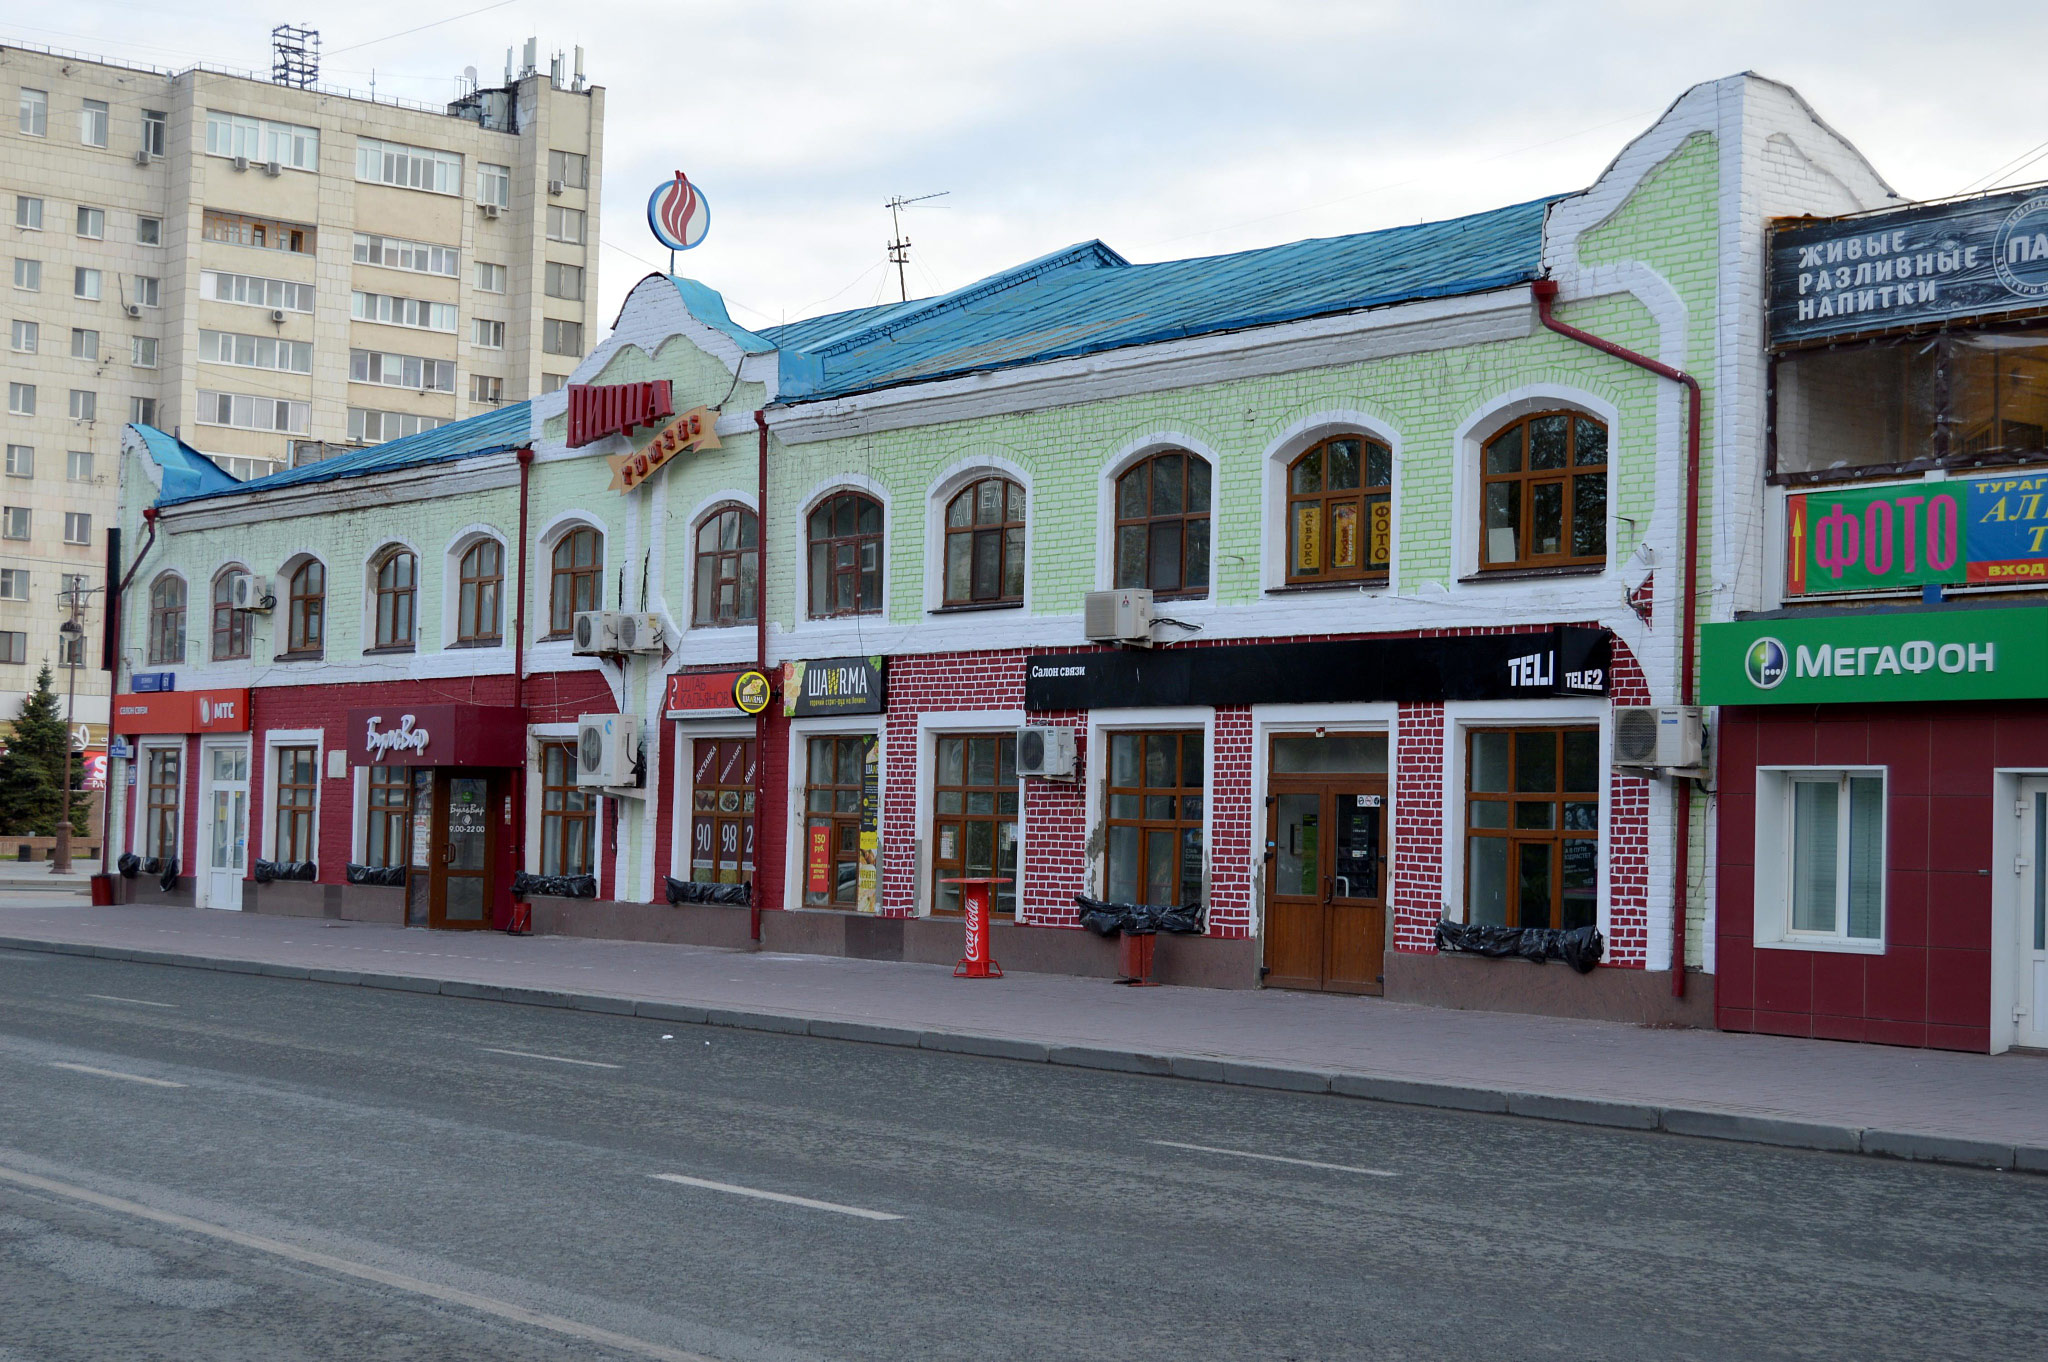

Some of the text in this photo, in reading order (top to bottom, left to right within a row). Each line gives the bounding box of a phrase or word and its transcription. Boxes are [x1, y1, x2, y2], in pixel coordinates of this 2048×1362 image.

[2006, 200, 2048, 226] ЦЕНТРА
[1798, 230, 1905, 268] ЖИВЫЕ
[1798, 246, 1979, 295] РАЗЛИВНЫЕ
[1798, 280, 1936, 321] НАПИТКИ
[566, 380, 675, 449] ПИЦЦА
[1979, 493, 2048, 523] АЛ
[1375, 505, 1390, 560] ФОТО
[1815, 494, 1958, 579] ФОТО
[1988, 563, 2045, 577] ВХОД
[681, 676, 706, 692] ШТАБ
[1031, 665, 1085, 678] Салон связи
[1565, 668, 1603, 690] TELE2
[214, 702, 235, 719] МТС
[681, 691, 729, 707] КАЛЬЯНОВ
[696, 824, 711, 851] 90
[722, 824, 737, 853] 98
[814, 833, 826, 844] 150
